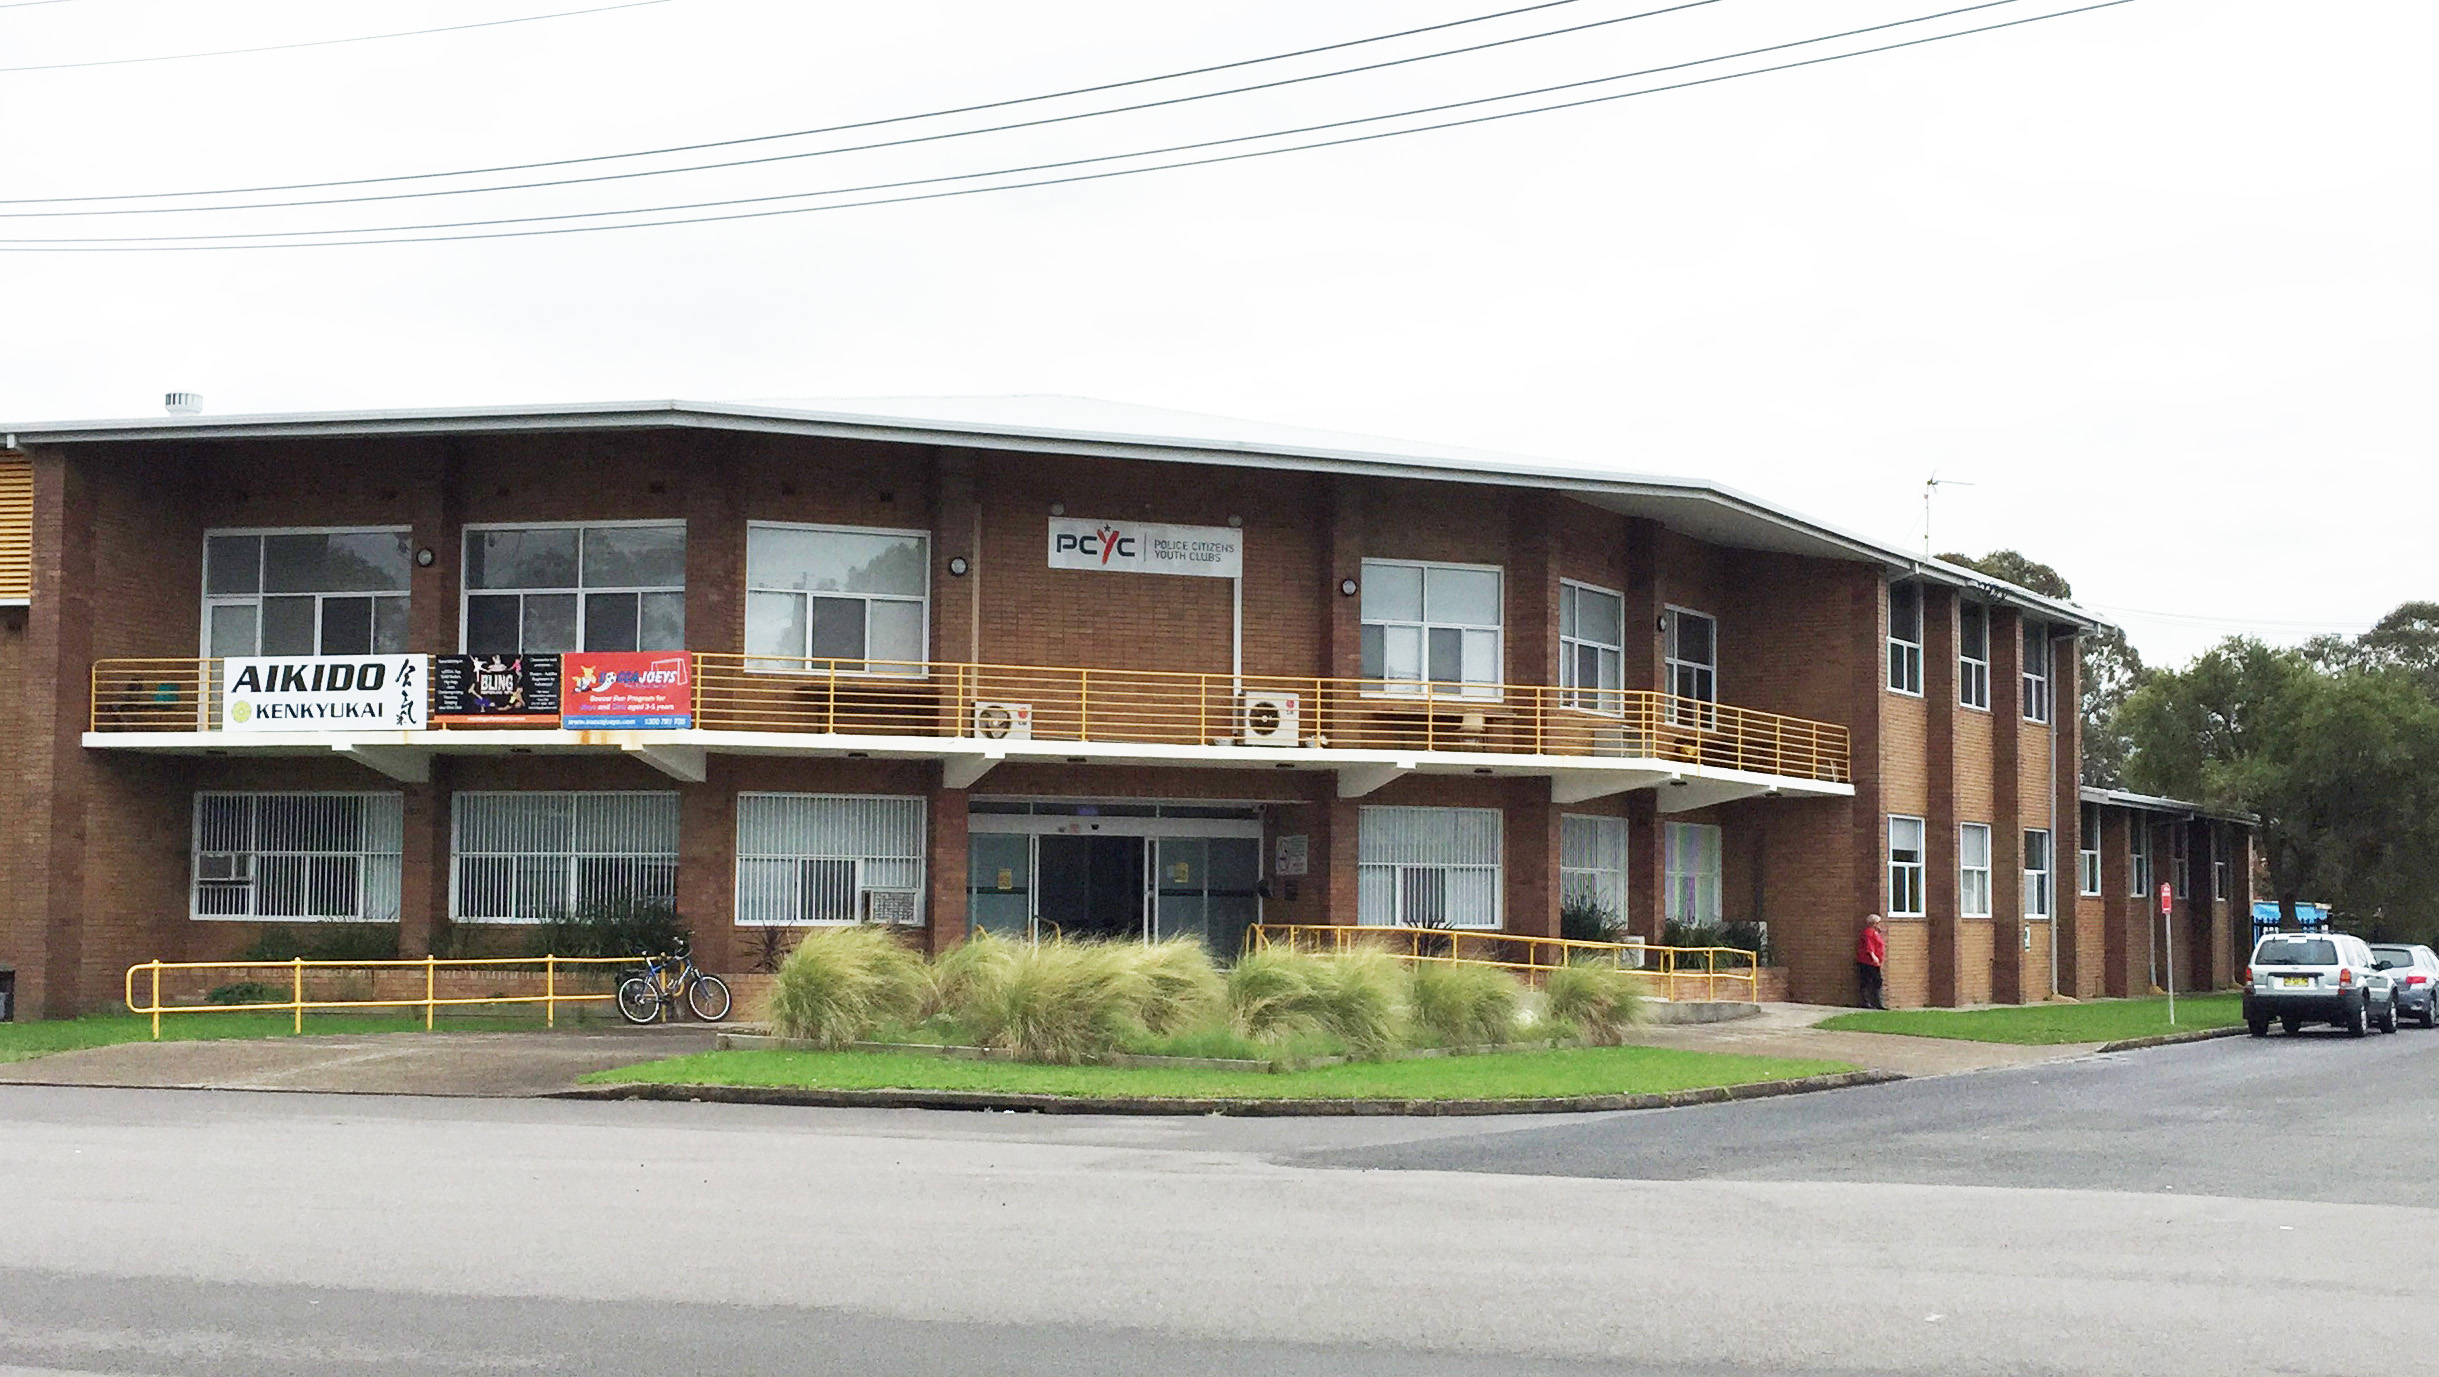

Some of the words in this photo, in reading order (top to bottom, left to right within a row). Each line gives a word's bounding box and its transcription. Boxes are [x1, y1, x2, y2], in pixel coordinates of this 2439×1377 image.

[1056, 529, 1135, 565] PCYC
[1154, 539, 1188, 550] POLICE
[1191, 541, 1235, 553] CITIZENS
[1154, 550, 1186, 560] YOUTH
[1189, 552, 1221, 562] CLUBS
[231, 663, 386, 693] AIKIDO
[481, 674, 513, 691] BLING
[256, 702, 383, 719] KENKYUKAI
